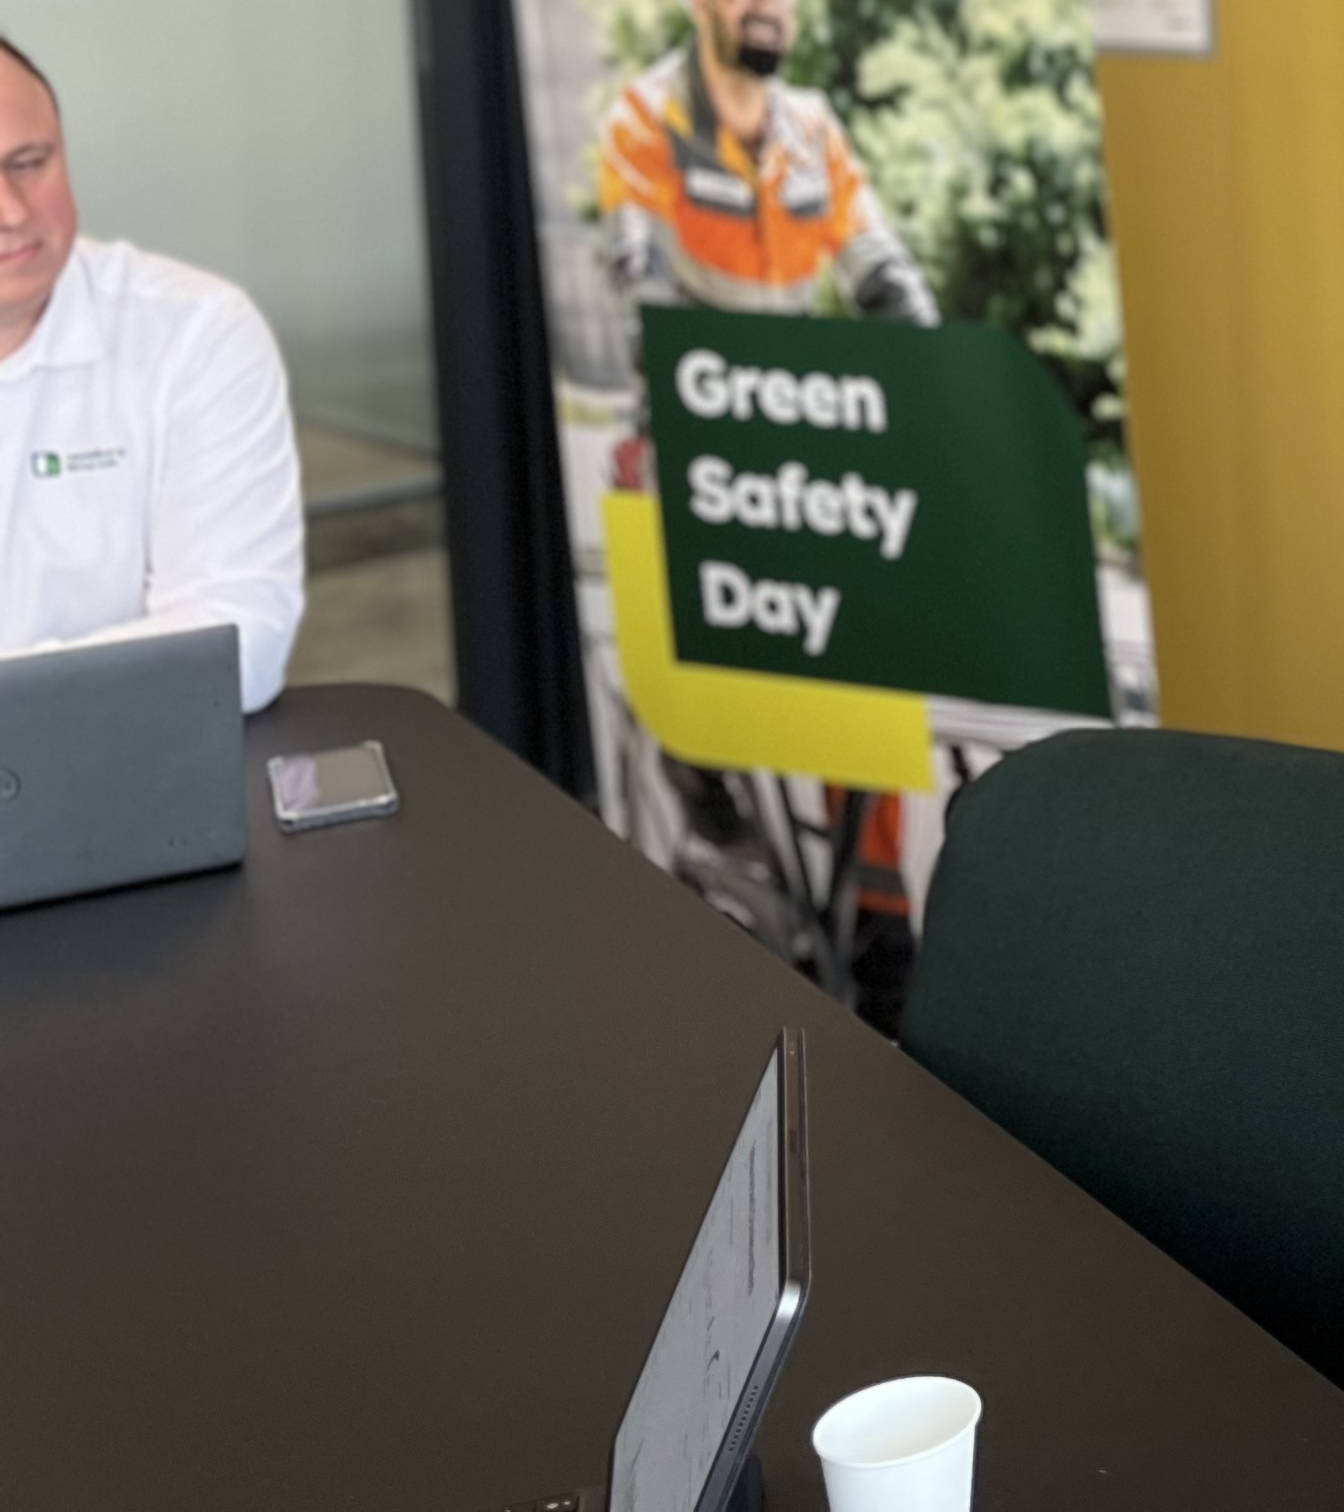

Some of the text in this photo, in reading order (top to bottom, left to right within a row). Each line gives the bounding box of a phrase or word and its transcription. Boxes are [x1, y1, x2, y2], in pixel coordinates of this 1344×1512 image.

[676, 348, 888, 433] Green
[688, 455, 917, 560] Safety
[699, 560, 841, 656] Day
